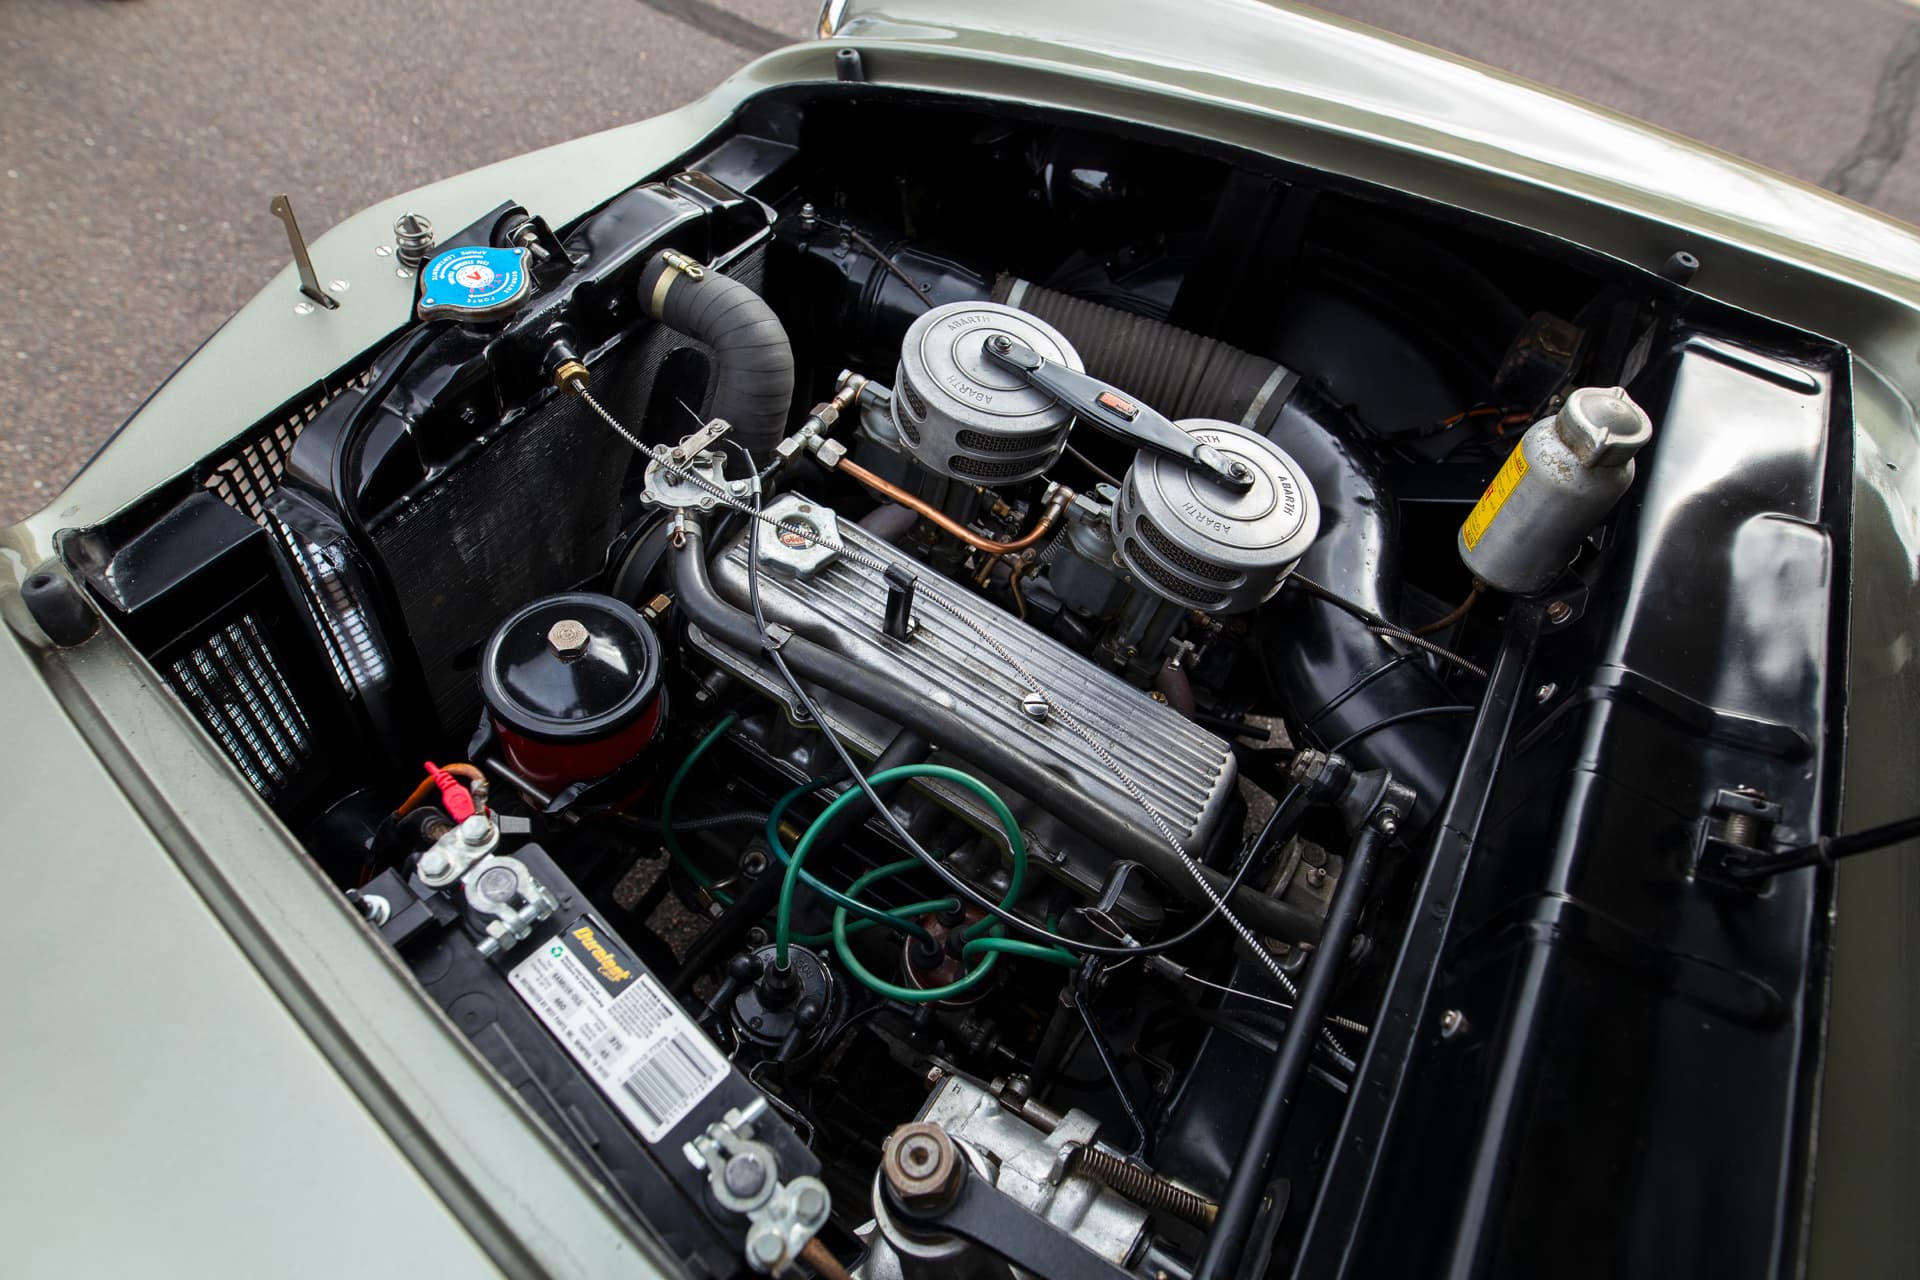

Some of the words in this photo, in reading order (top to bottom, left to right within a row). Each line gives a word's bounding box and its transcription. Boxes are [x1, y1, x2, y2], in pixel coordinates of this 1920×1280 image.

[947, 315, 991, 331] ABARTH
[945, 375, 993, 405] ABARTH
[1278, 475, 1295, 516] ABARTH
[1182, 501, 1232, 534] ABARTH
[572, 926, 631, 980] Duralast
